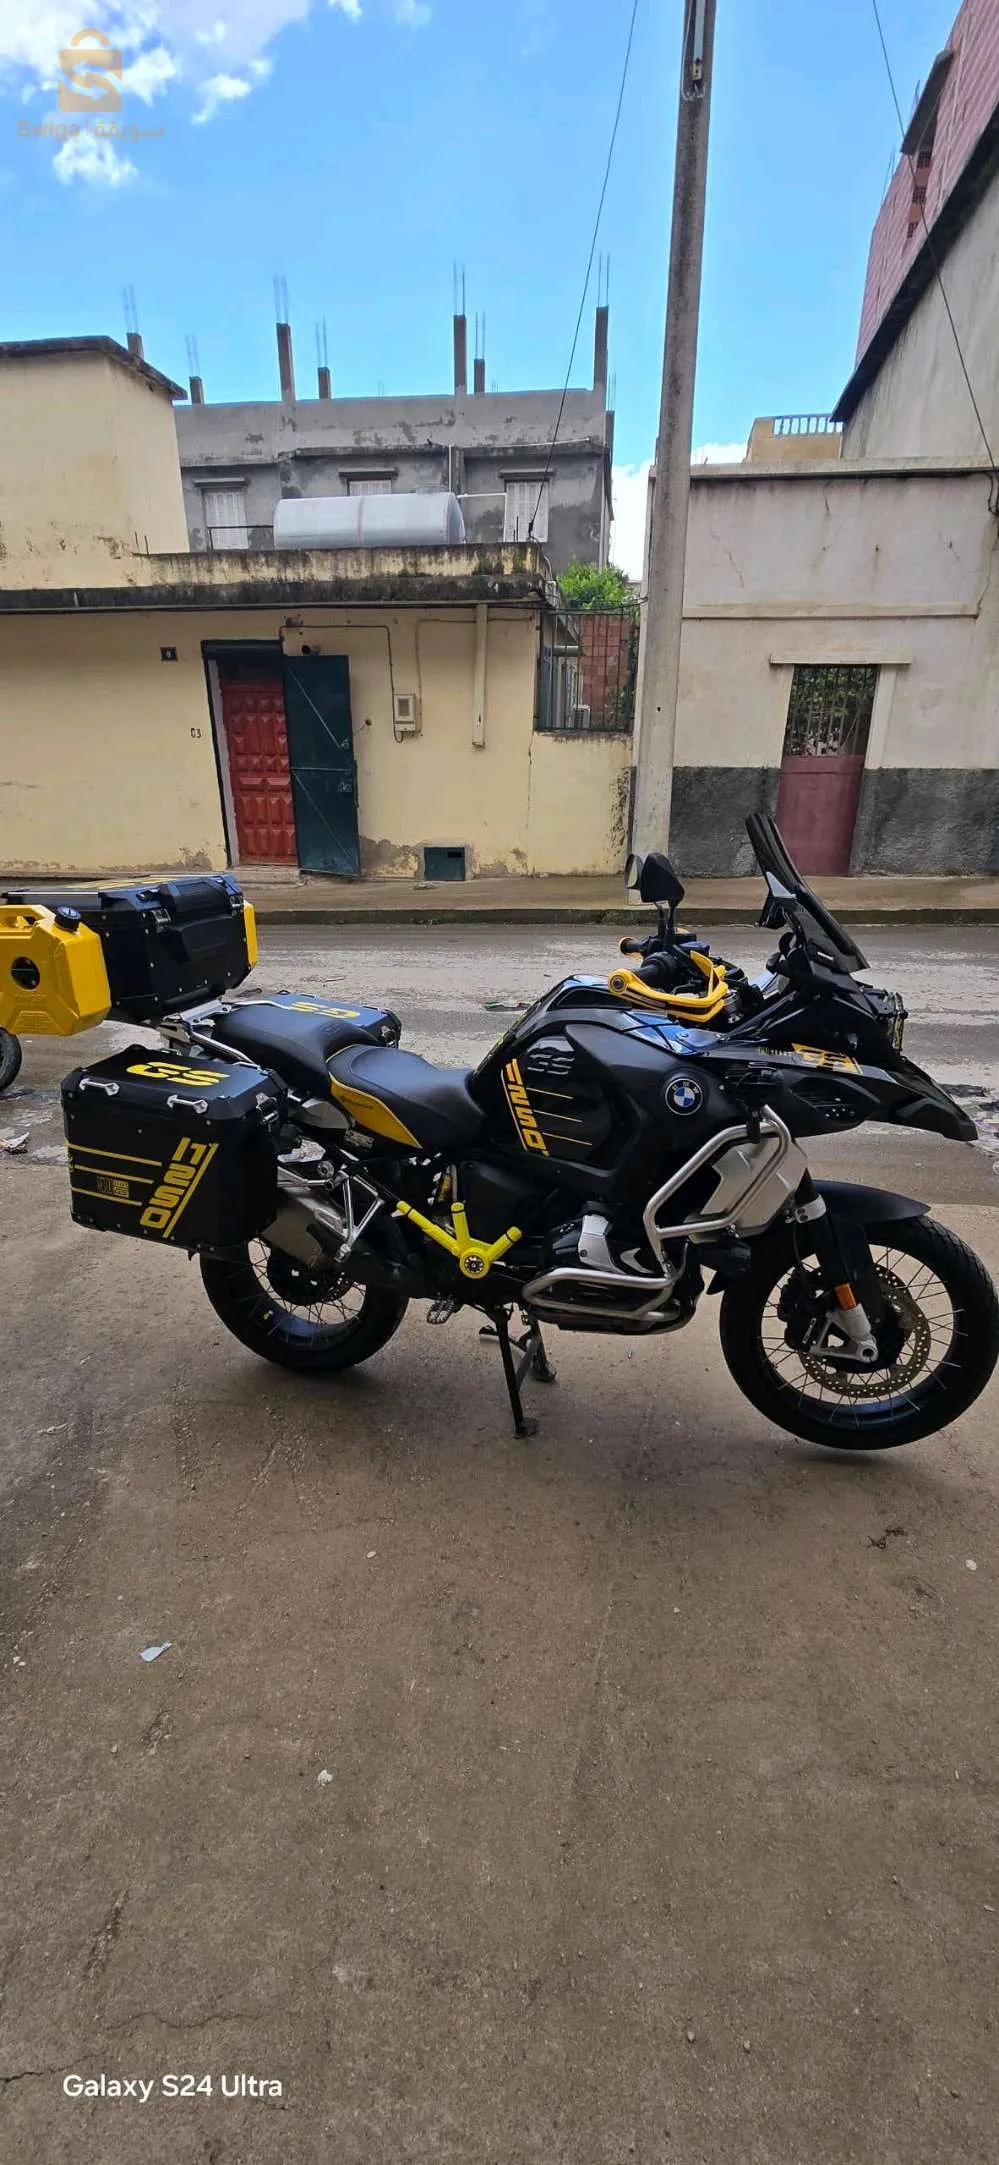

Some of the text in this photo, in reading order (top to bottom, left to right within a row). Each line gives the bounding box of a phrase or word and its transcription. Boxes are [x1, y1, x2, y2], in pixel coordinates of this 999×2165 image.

[126, 1061, 231, 1087] GS
[671, 1080, 700, 1095] BMW
[140, 1136, 207, 1230] 1250
